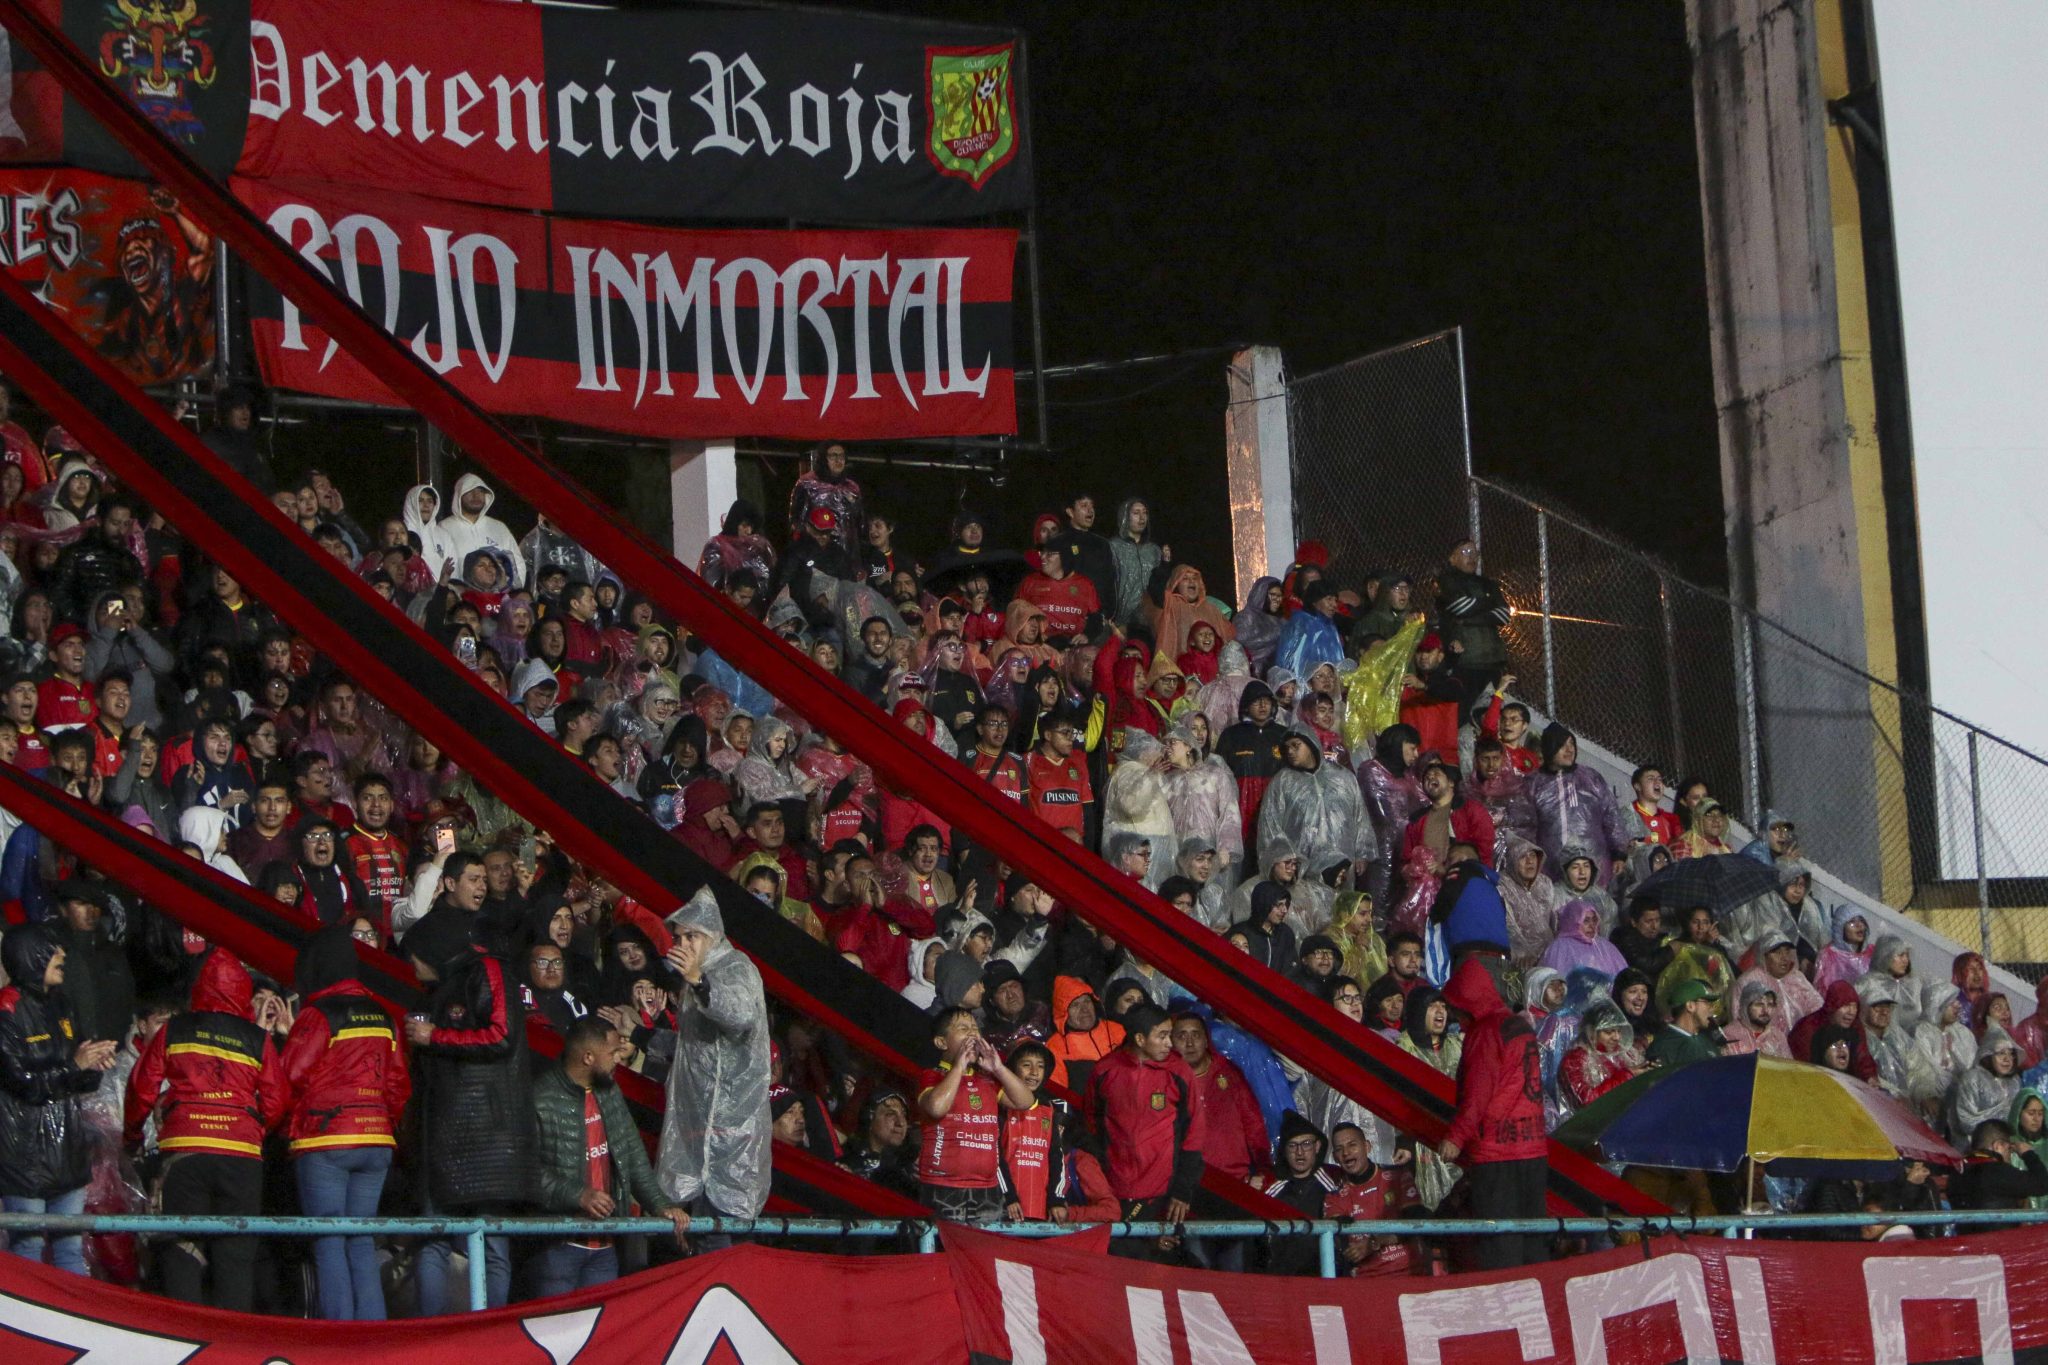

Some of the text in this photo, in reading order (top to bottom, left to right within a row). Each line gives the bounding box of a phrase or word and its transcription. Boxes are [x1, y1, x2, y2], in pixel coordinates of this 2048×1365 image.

[265, 203, 991, 419] ROJO INMORTAL
[956, 1131, 995, 1142] CHUBB
